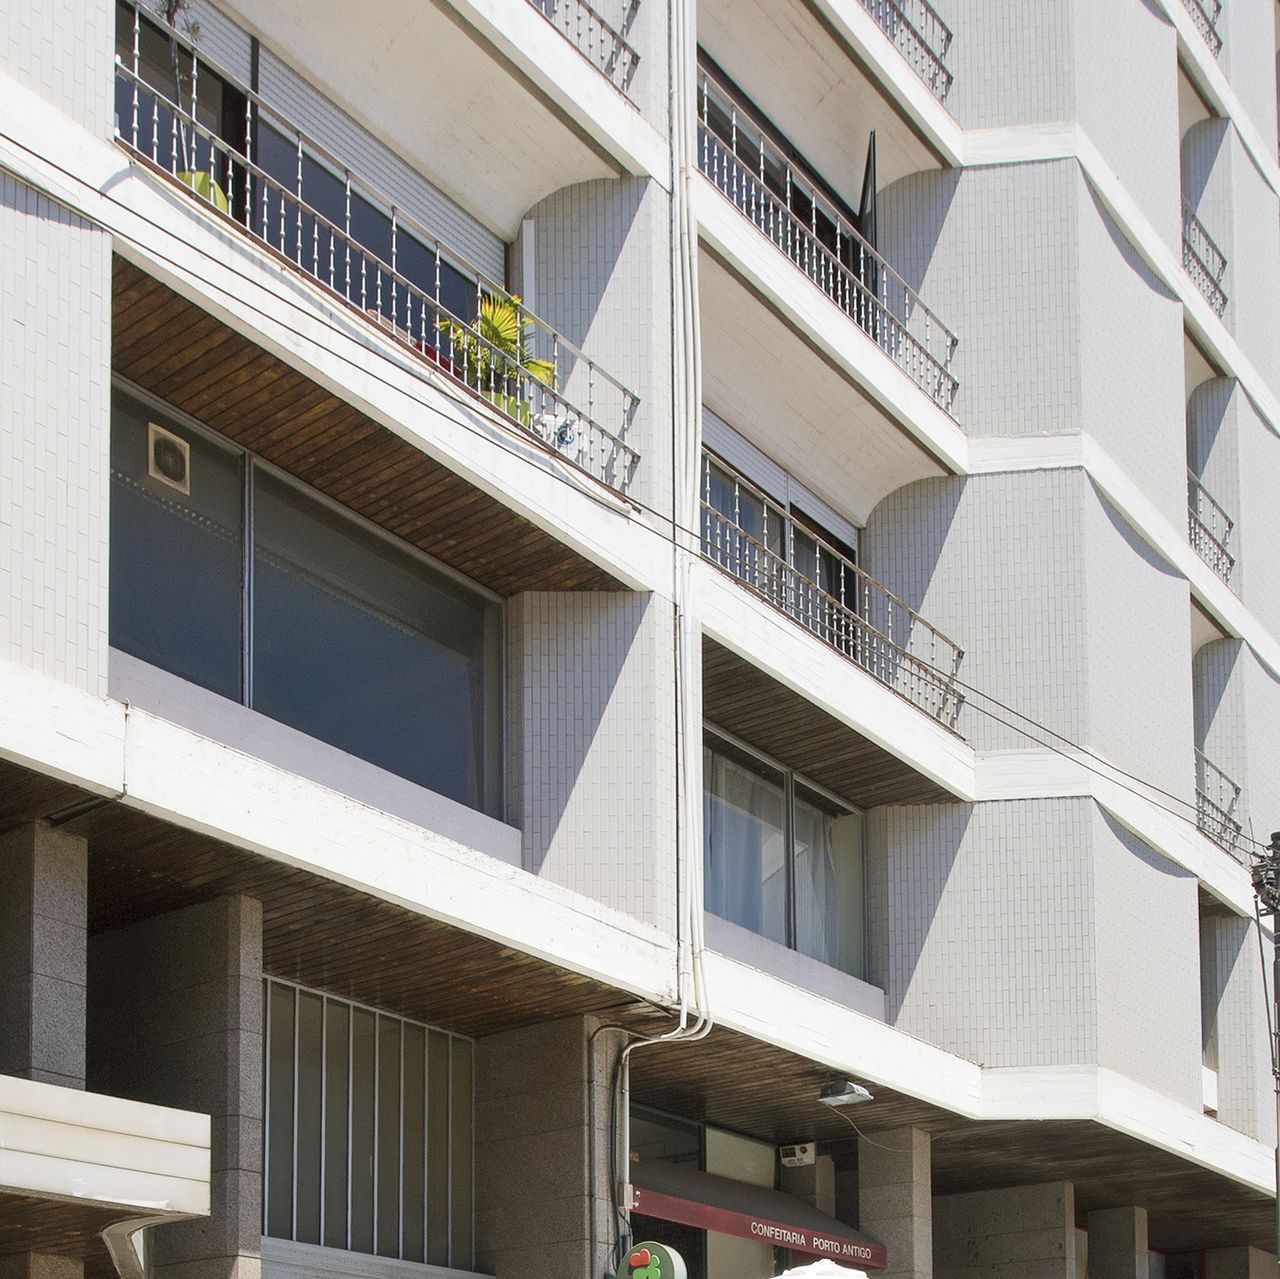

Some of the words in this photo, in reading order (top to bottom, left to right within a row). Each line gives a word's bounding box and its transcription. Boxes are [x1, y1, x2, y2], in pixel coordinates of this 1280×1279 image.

[750, 1221, 807, 1246] CONFEITARIA
[812, 1237, 841, 1254] PORTO
[841, 1244, 872, 1260] ANTIGO
